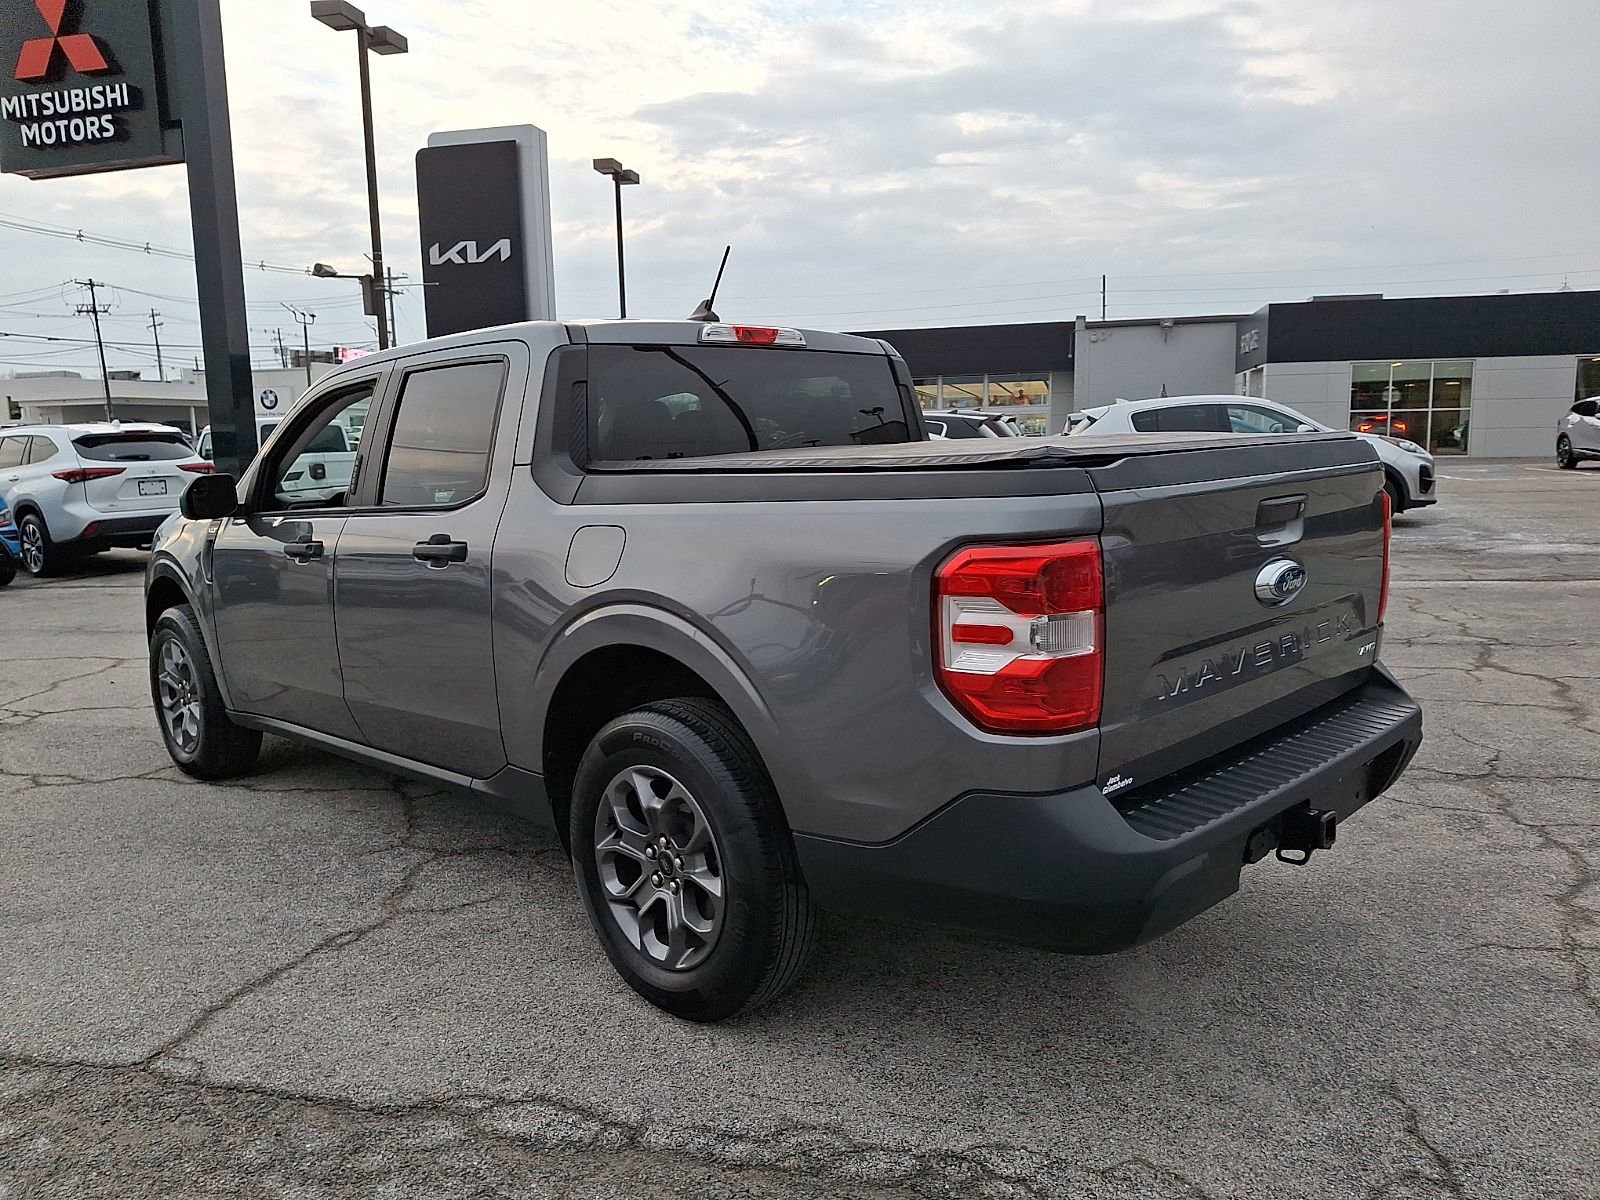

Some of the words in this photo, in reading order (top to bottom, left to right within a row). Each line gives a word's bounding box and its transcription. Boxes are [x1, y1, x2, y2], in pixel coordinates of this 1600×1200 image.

[0, 82, 129, 120] MITSUBISHI
[20, 114, 115, 147] MOTORS
[429, 238, 511, 265] KIA
[1282, 570, 1303, 592] Ford
[1156, 612, 1351, 700] MAVERICK
